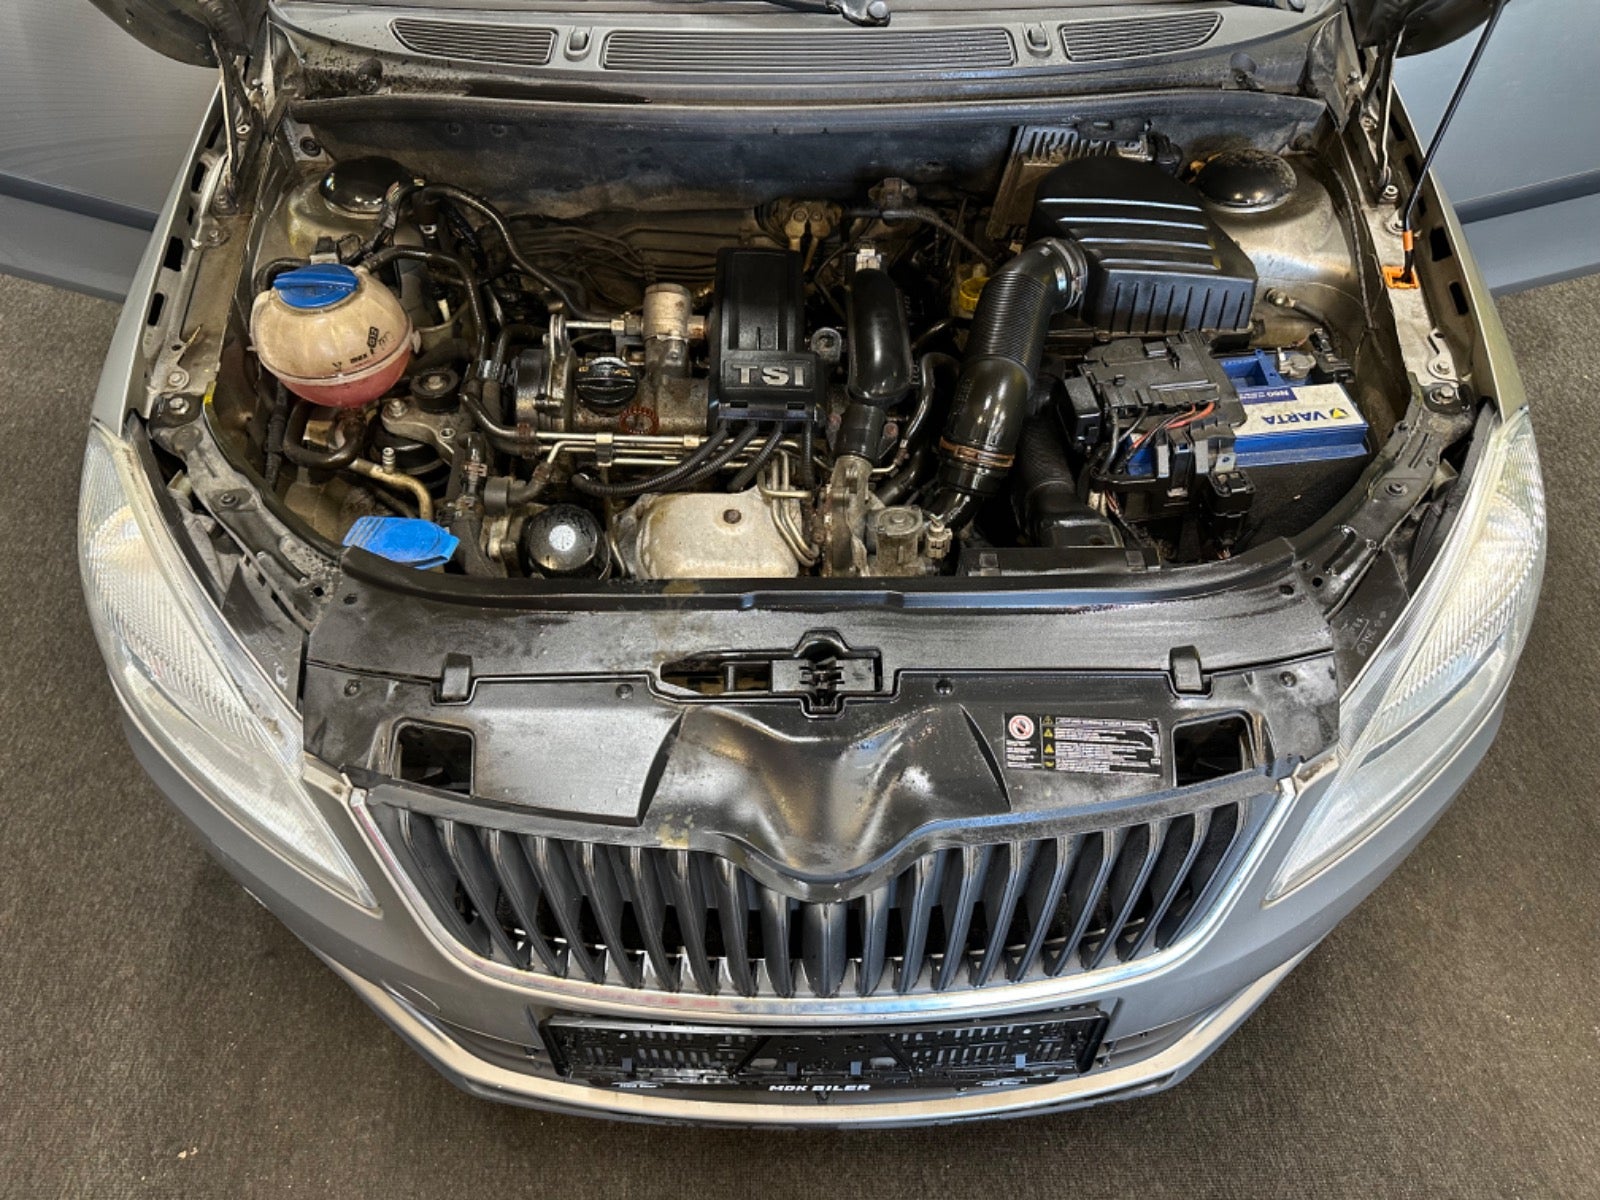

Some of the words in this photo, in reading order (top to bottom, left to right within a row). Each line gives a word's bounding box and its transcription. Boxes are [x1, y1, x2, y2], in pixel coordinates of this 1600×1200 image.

[732, 364, 804, 386] TSI
[1261, 410, 1327, 425] VARTA
[811, 1084, 871, 1092] BILER
